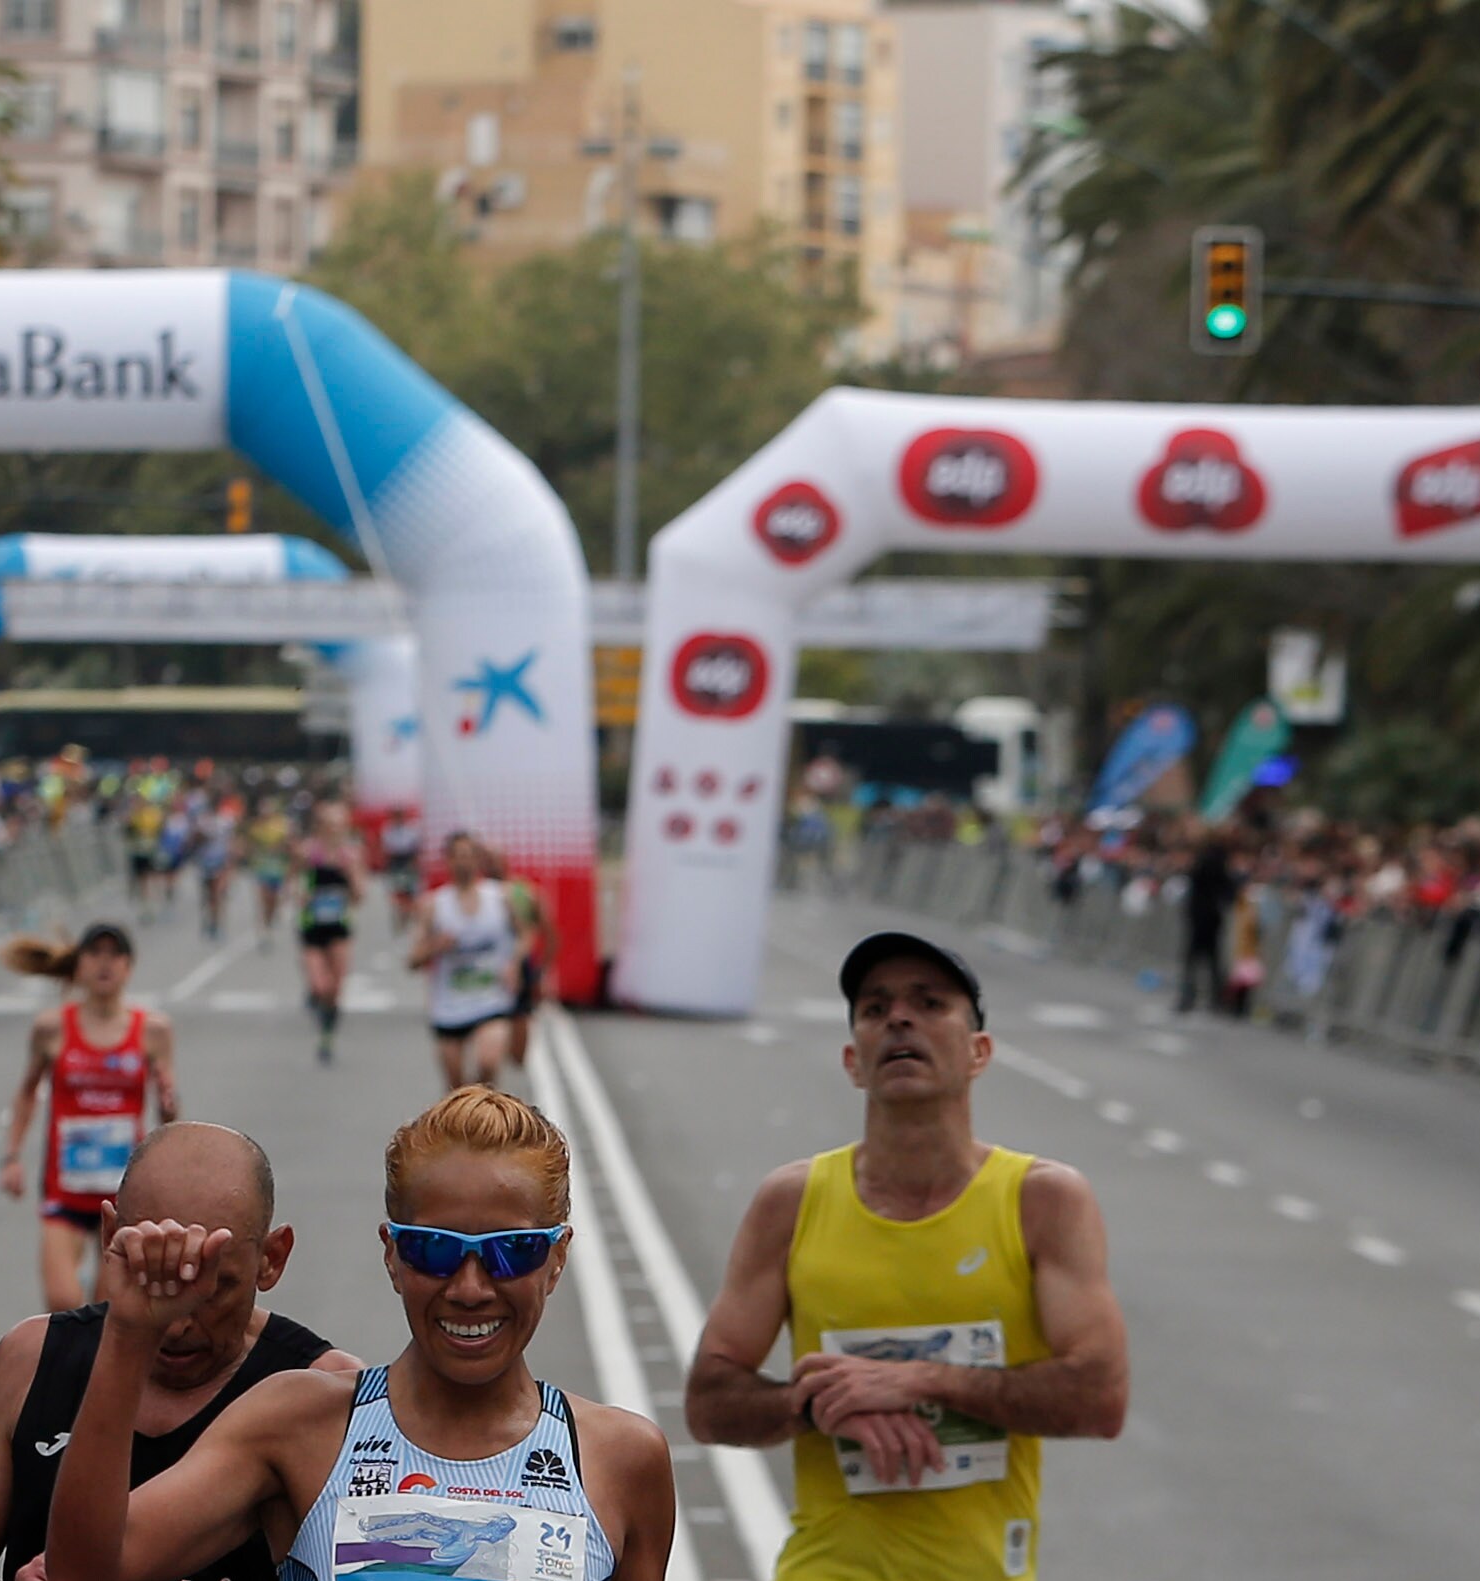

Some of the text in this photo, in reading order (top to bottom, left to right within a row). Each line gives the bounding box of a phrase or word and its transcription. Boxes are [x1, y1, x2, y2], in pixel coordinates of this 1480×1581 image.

[447, 1486, 526, 1500] COSTA DEL SOL
